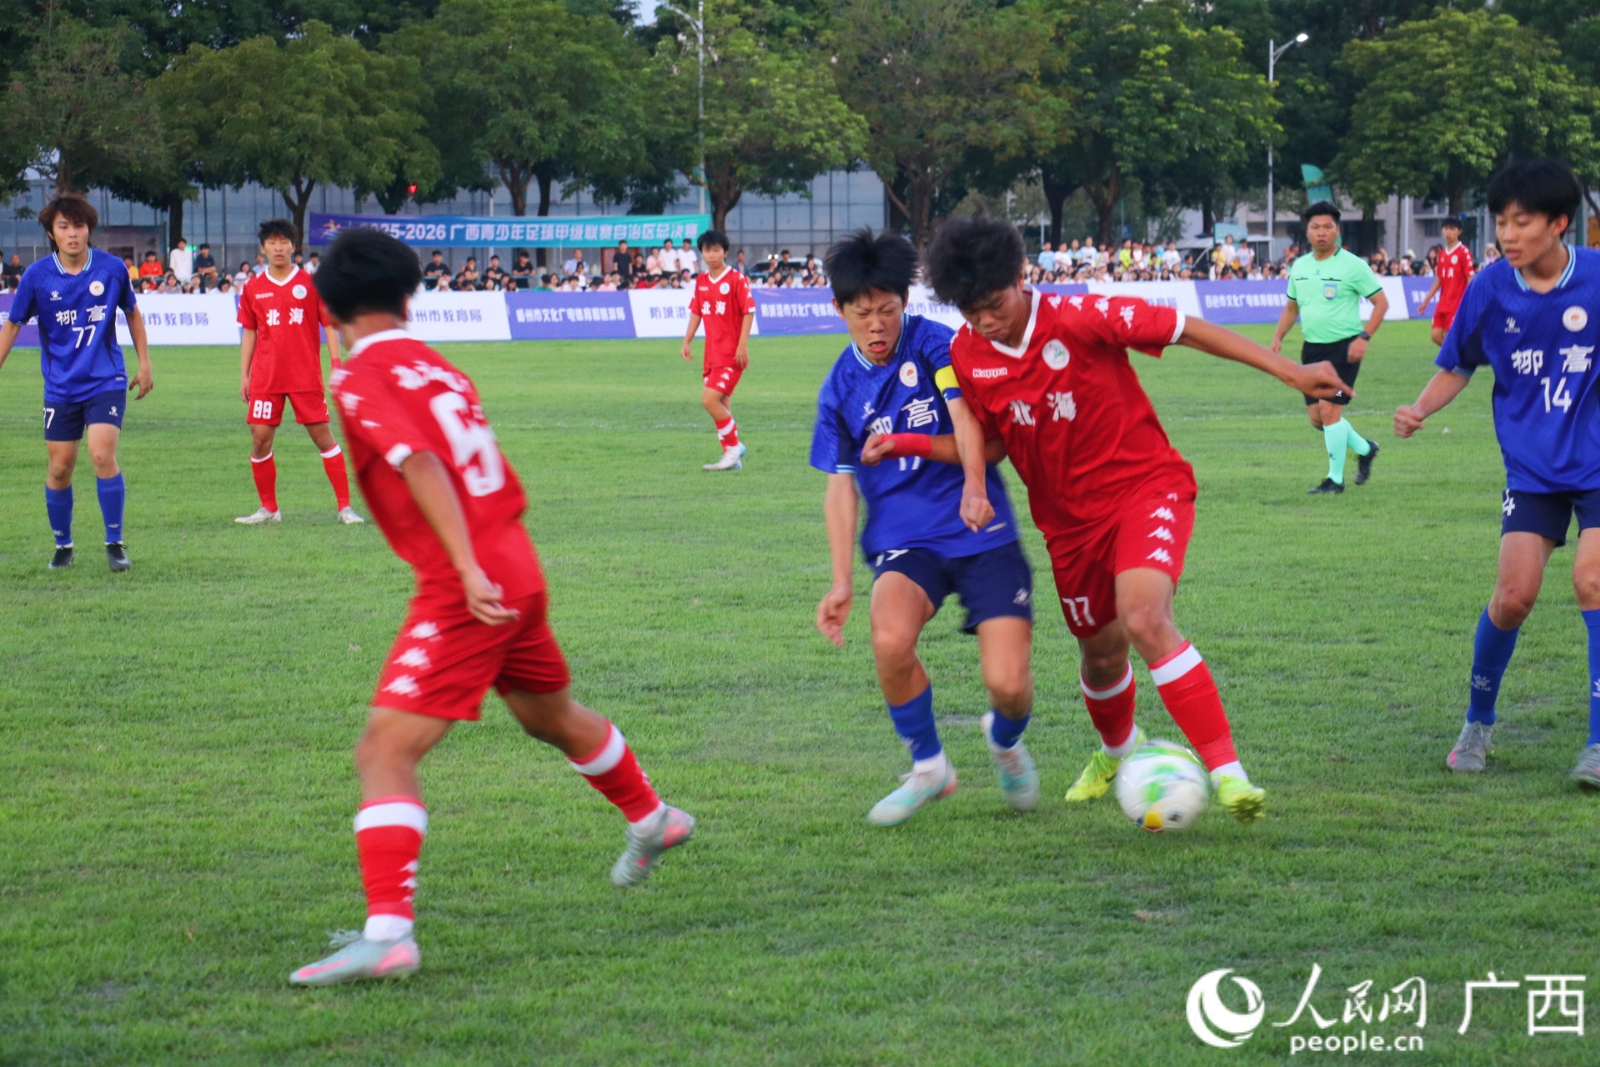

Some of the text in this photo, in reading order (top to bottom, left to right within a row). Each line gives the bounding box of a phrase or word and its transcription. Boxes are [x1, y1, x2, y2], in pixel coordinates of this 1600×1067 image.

[55, 305, 107, 326] 柳高
[116, 311, 209, 326] 市教育局
[266, 307, 304, 327] 北海
[72, 324, 96, 348] 77
[973, 366, 1008, 379] Kappa
[1511, 344, 1595, 377] 柳高
[1540, 377, 1573, 413] 14
[1009, 391, 1077, 426] 北海
[1061, 596, 1096, 627] 77
